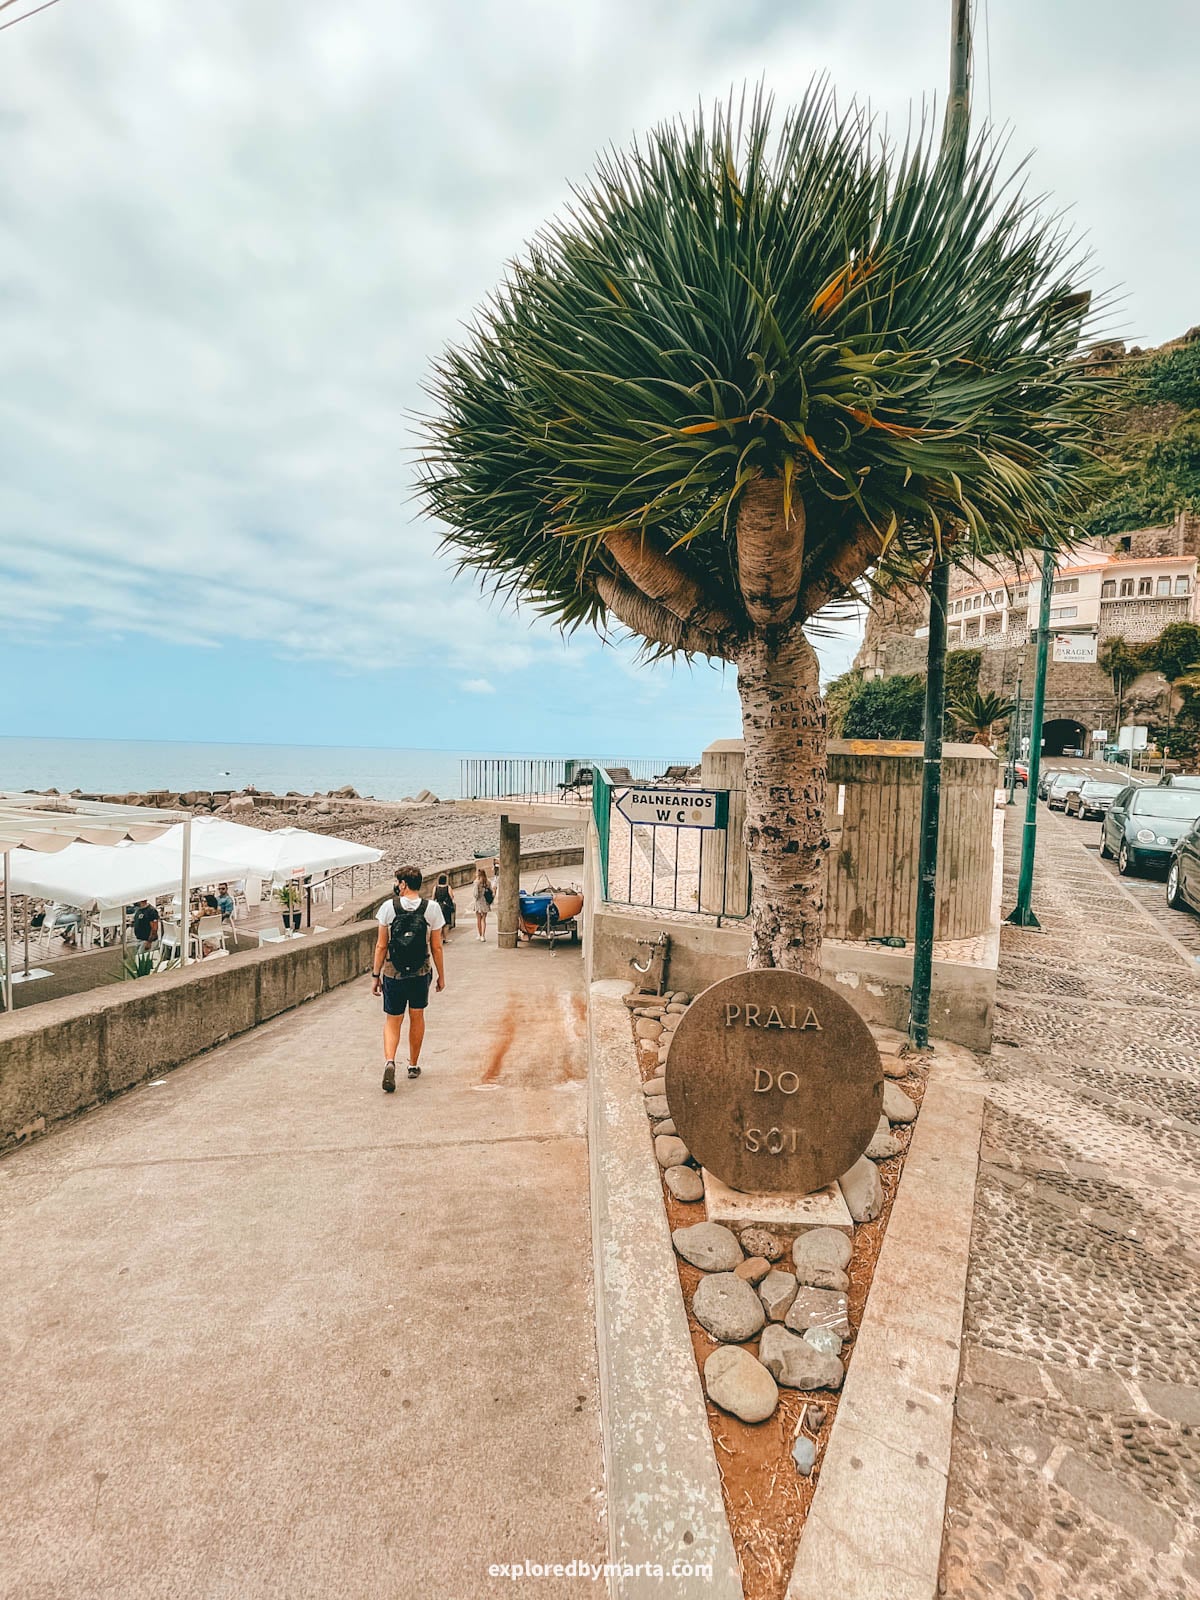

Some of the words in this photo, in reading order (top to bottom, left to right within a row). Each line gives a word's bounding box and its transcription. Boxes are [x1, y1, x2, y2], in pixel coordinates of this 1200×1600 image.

[632, 794, 712, 808] BALNEARIOS
[725, 1003, 823, 1030] PRAIA
[754, 1068, 800, 1095] DO
